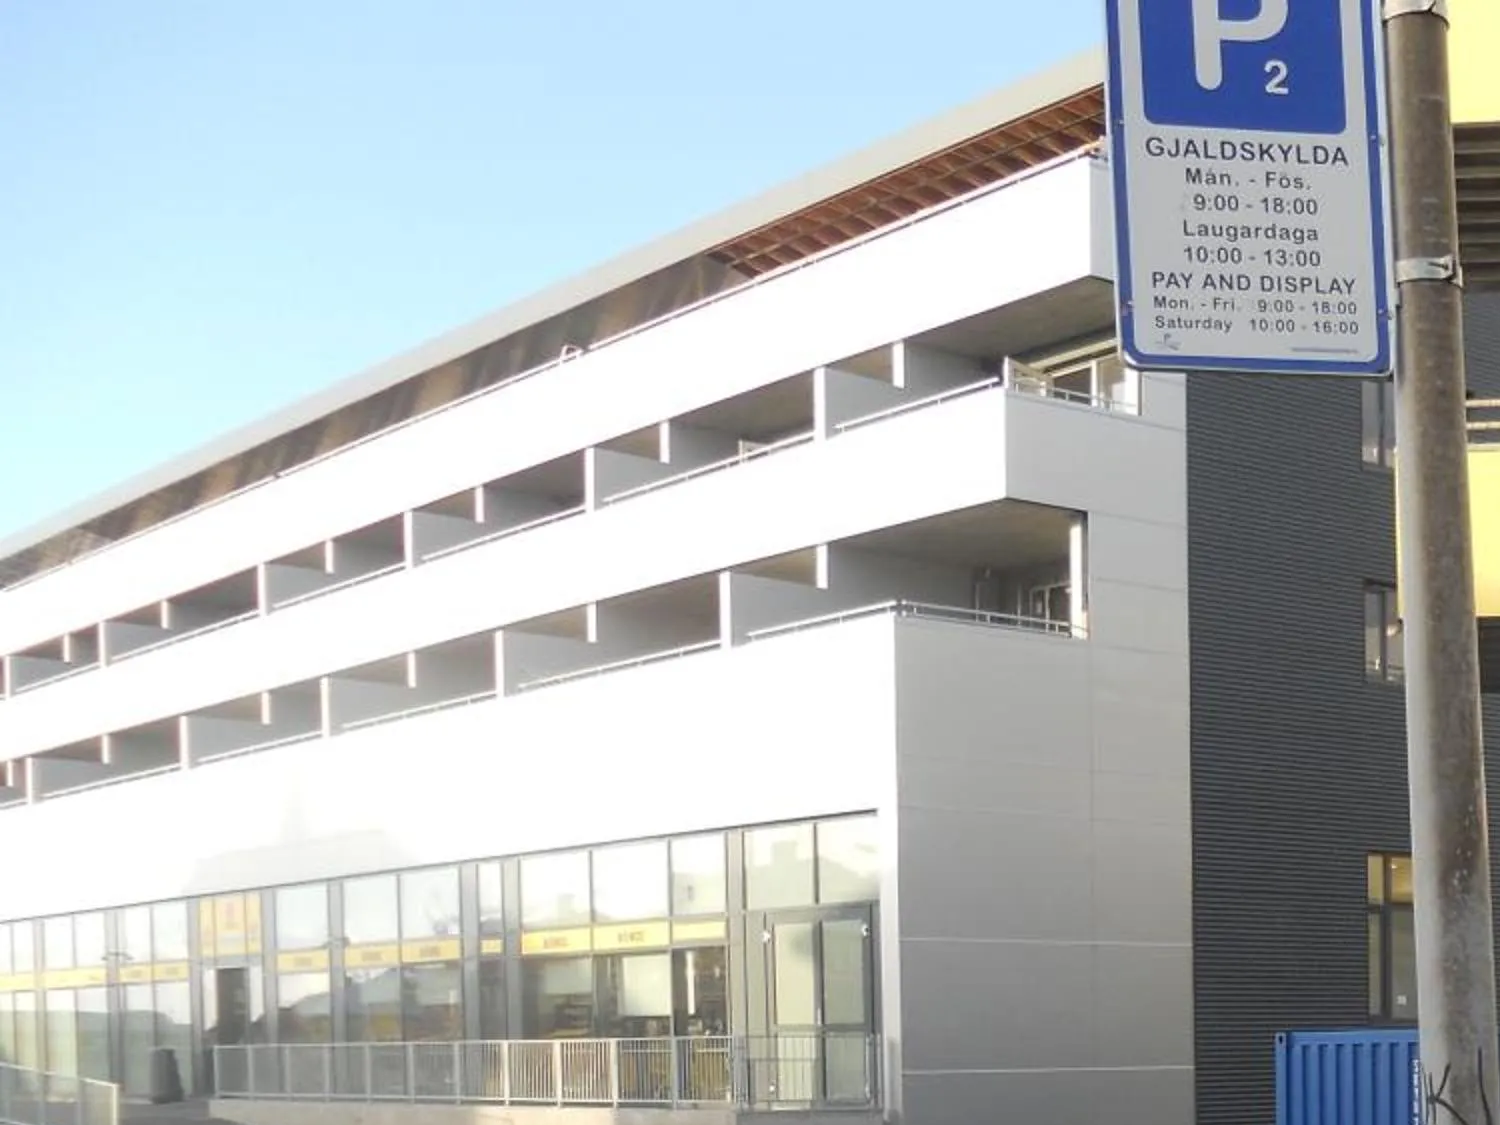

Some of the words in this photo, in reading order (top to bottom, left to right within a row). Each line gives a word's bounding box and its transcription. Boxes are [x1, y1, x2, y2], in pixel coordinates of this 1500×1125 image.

[1264, 60, 1290, 95] 2
[1145, 137, 1350, 166] GJALDSKYLDA
[1193, 194, 1239, 212] 9:00
[1260, 197, 1318, 215] 18:00
[1182, 219, 1319, 245] Laugardaga
[1183, 246, 1243, 264] 10:00
[1263, 249, 1321, 267] 13:00
[1151, 271, 1193, 289] PAY
[1202, 273, 1251, 292] AND
[1260, 275, 1356, 295] DISPLAY
[1153, 296, 1195, 311] Mon.
[1257, 299, 1295, 313] 9:00
[1155, 315, 1233, 333] Saturday
[1249, 318, 1296, 333] 10:00
